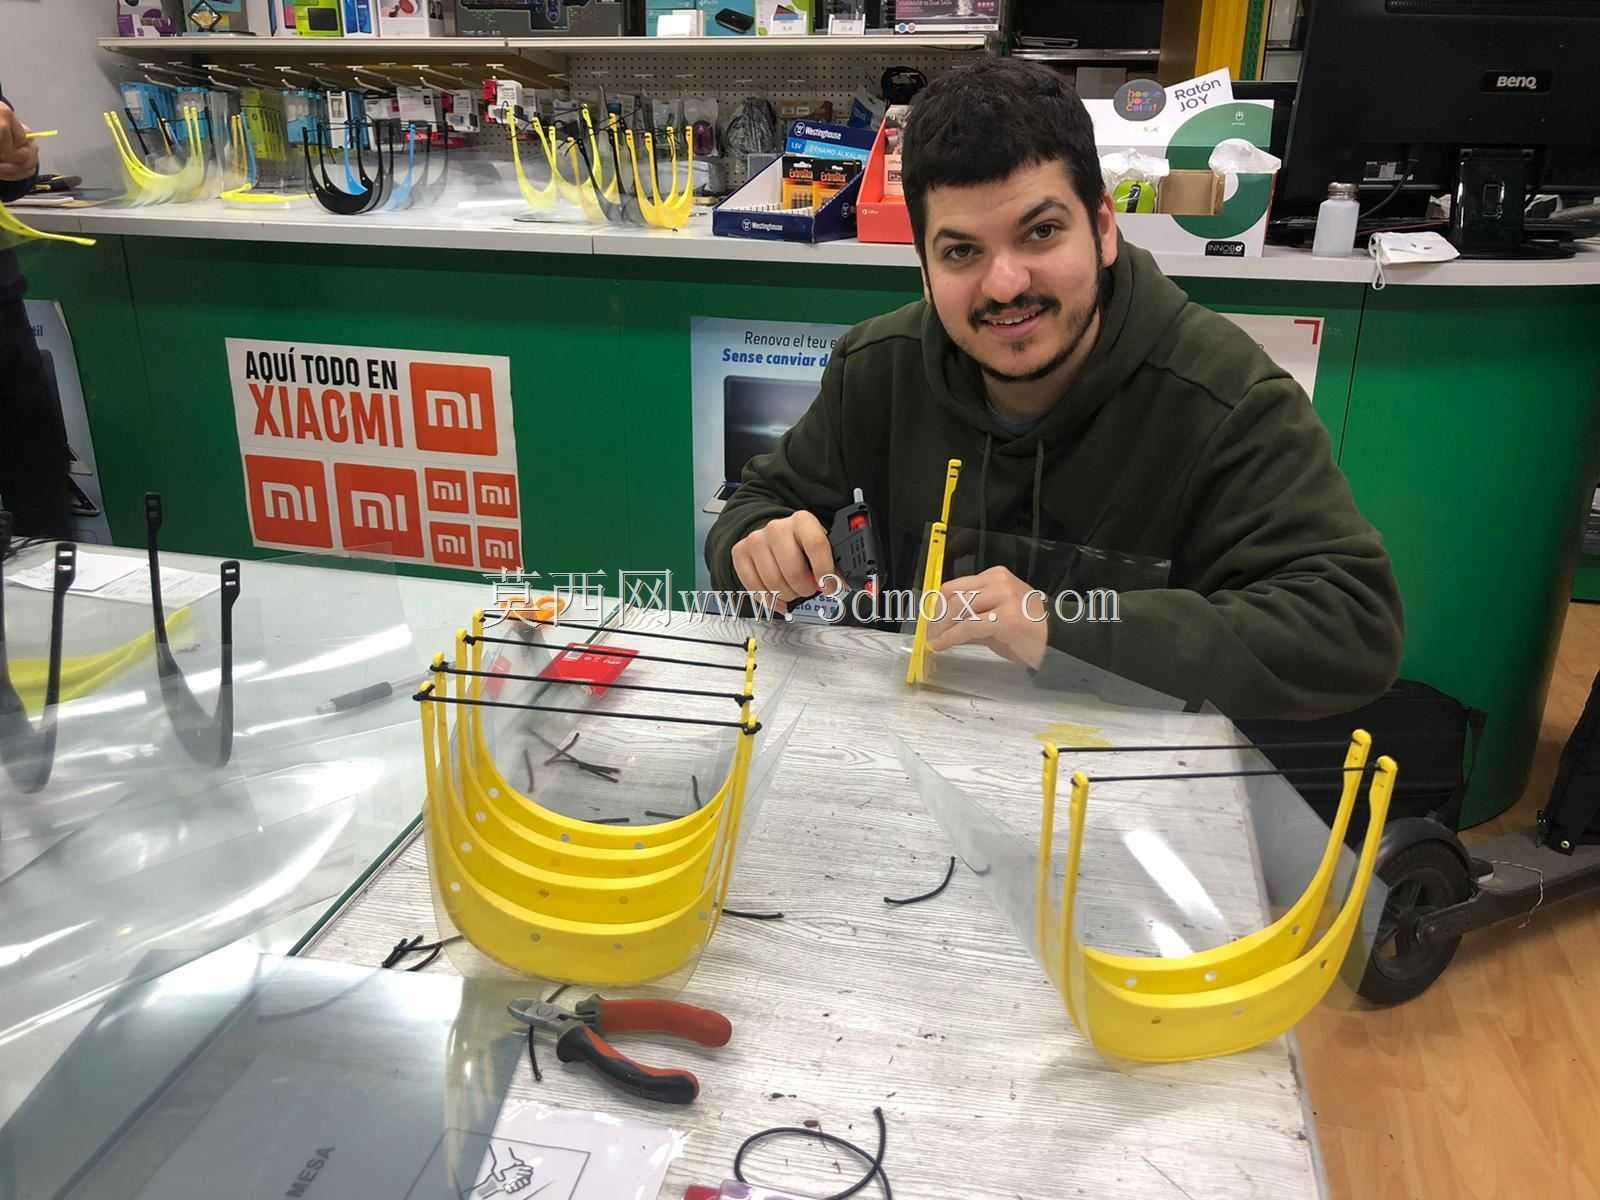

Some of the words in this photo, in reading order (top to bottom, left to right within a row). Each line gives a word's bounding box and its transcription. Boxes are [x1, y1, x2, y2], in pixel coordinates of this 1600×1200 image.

[1174, 79, 1222, 101] Ratón
[1180, 94, 1209, 112] JOY
[805, 126, 842, 140] Westinghouse
[744, 331, 790, 348] Renova
[793, 335, 804, 348] el
[807, 336, 827, 349] teu
[245, 347, 297, 384] AQUÍ
[301, 354, 360, 389] TODO
[367, 359, 398, 390] EN
[722, 348, 763, 364] Sense
[766, 352, 817, 368] canviar
[248, 383, 404, 448] XIAOMI
[285, 1146, 336, 1198] MESA
